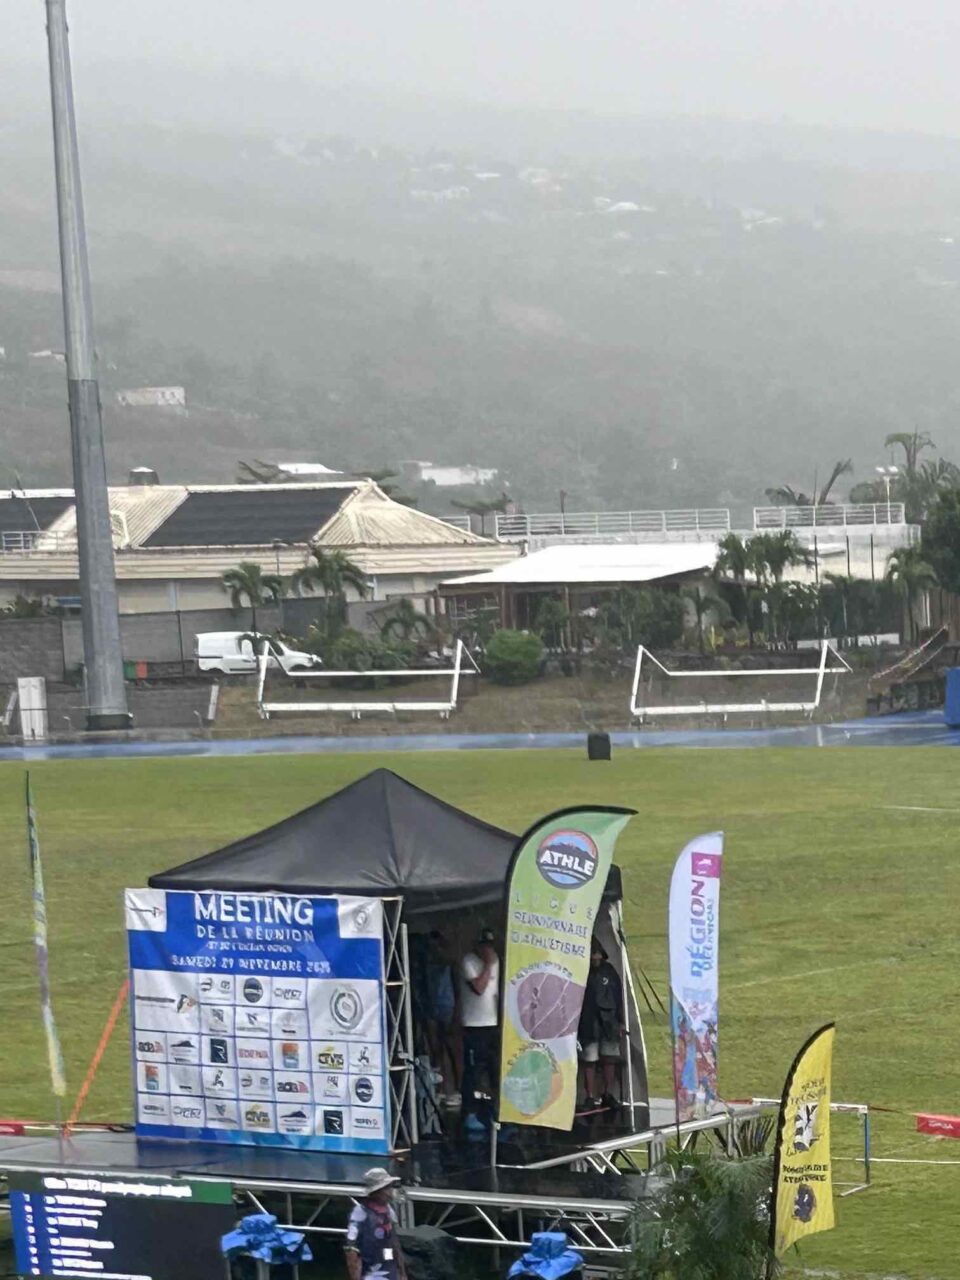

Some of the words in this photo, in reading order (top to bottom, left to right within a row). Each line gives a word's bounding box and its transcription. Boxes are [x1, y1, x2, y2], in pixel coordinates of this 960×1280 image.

[194, 893, 314, 926] MEETING
[196, 925, 216, 939] DE
[171, 954, 217, 968] SAMEDI
